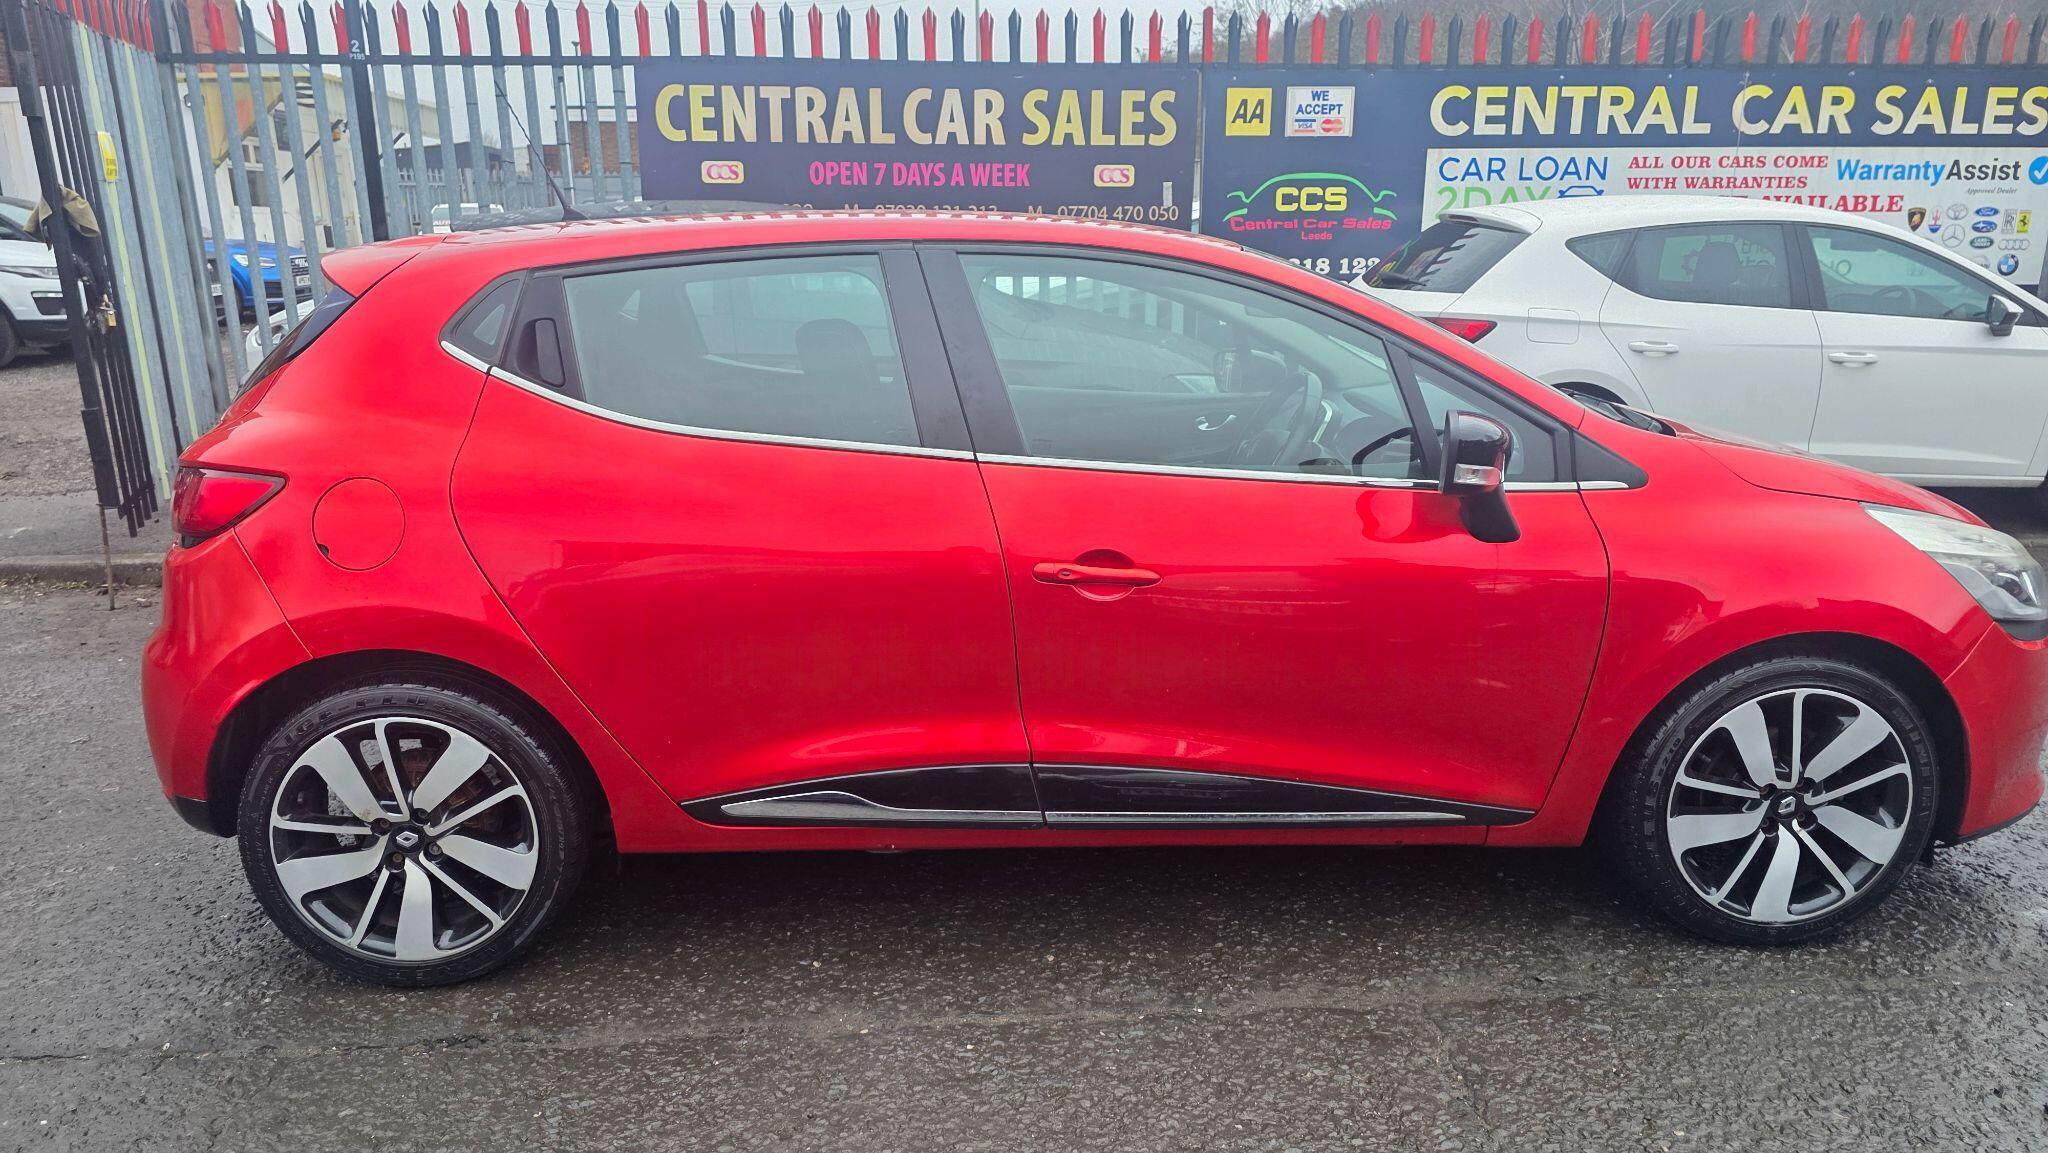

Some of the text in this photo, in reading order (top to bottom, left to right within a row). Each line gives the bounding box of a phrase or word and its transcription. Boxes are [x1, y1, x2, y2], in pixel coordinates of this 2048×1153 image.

[351, 40, 360, 52] 2
[1311, 90, 1330, 101] WE
[655, 83, 1177, 146] CENTRAL CAR SALES
[1231, 98, 1264, 123] AA
[1296, 103, 1343, 115] ACCEPT
[1430, 84, 2048, 137] CENTRAL CAR SALES
[1439, 156, 1608, 182] CAR LOAN
[1628, 155, 1829, 169] ALL OUR CARS COME
[706, 163, 739, 180] CCS
[809, 161, 1030, 187] OPEN 7 DAYS A WEEK
[1098, 168, 1130, 184] CCS
[1627, 176, 1808, 189] WITH WARRANTIES
[1997, 187, 2018, 195] Dealer
[1275, 187, 1347, 212] CCS
[1057, 206, 1108, 220] 07704
[1113, 206, 1143, 220] 470
[1149, 206, 1179, 221] 050
[1230, 217, 1392, 231] Central Car Sales
[1301, 232, 1332, 240] Leeds
